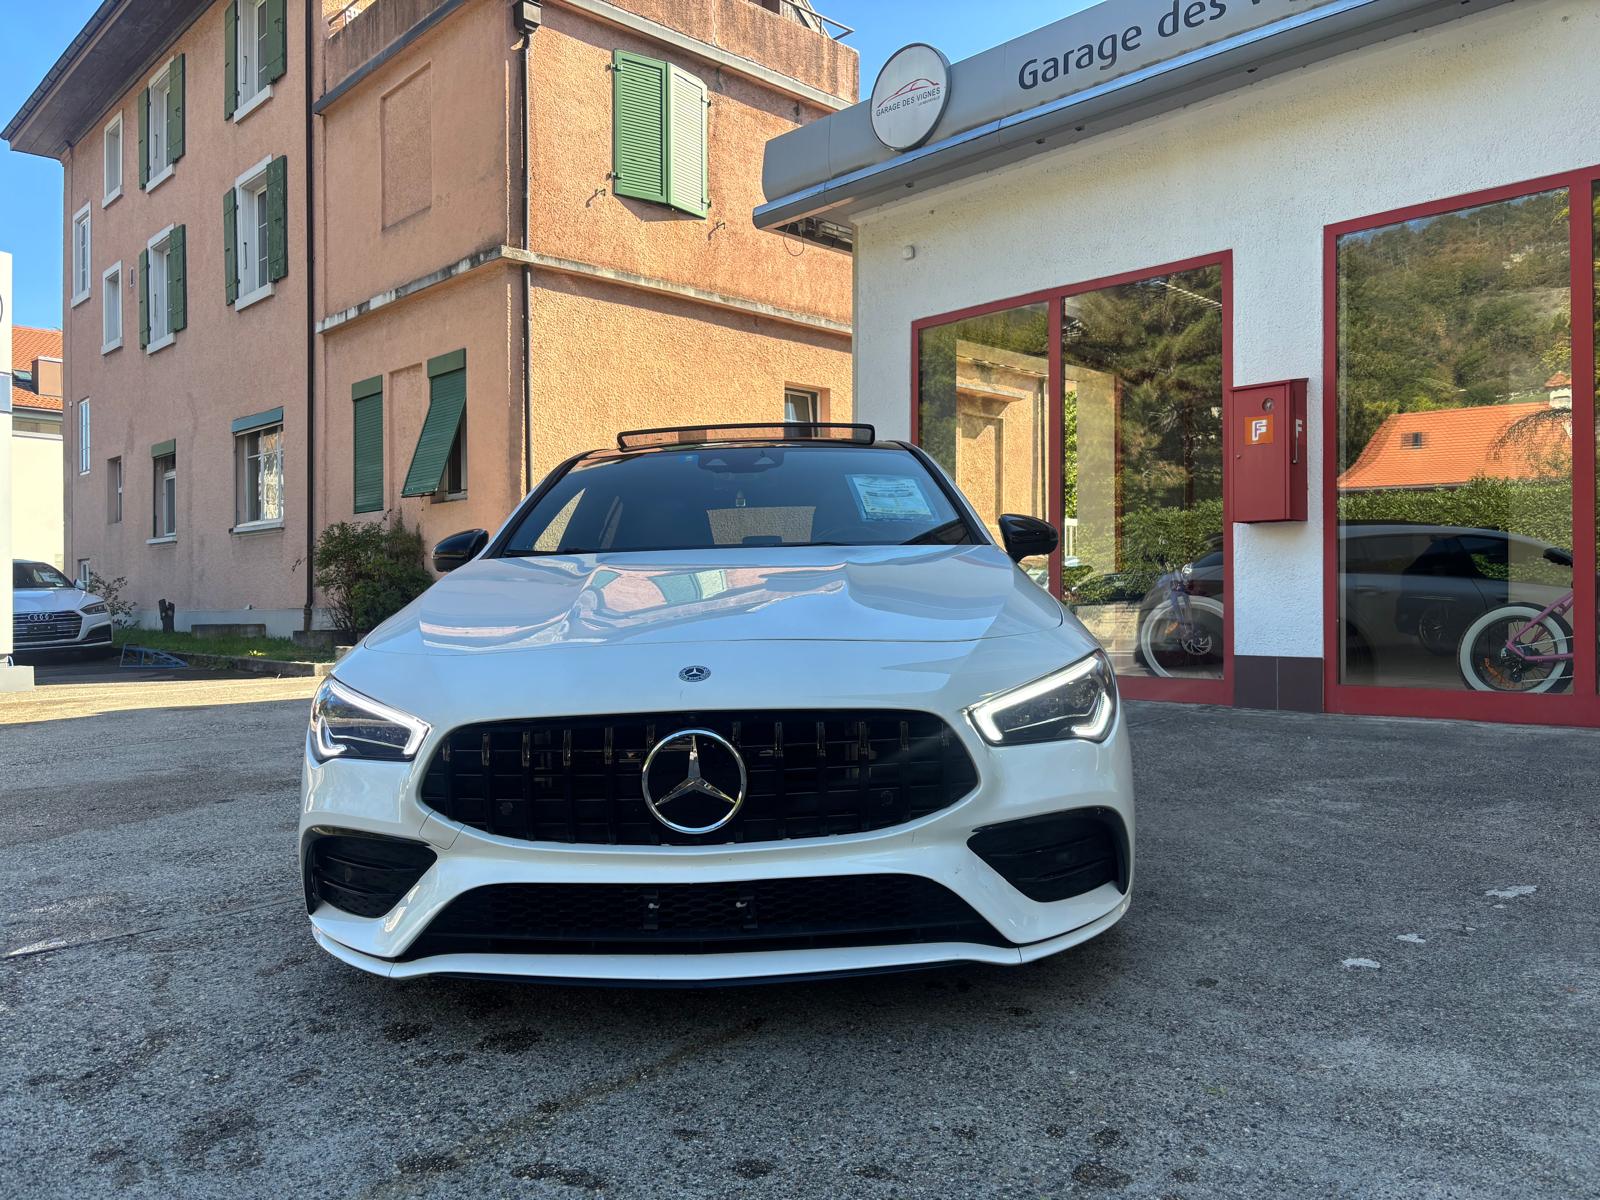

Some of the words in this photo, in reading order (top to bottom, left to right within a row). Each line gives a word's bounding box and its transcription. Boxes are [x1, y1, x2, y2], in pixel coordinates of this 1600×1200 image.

[1018, 25, 1142, 90] Garage
[1157, 0, 1226, 37] des
[876, 102, 900, 117] GARAGE
[902, 96, 915, 107] DES
[916, 87, 941, 102] VIGNES
[1251, 419, 1267, 442] F
